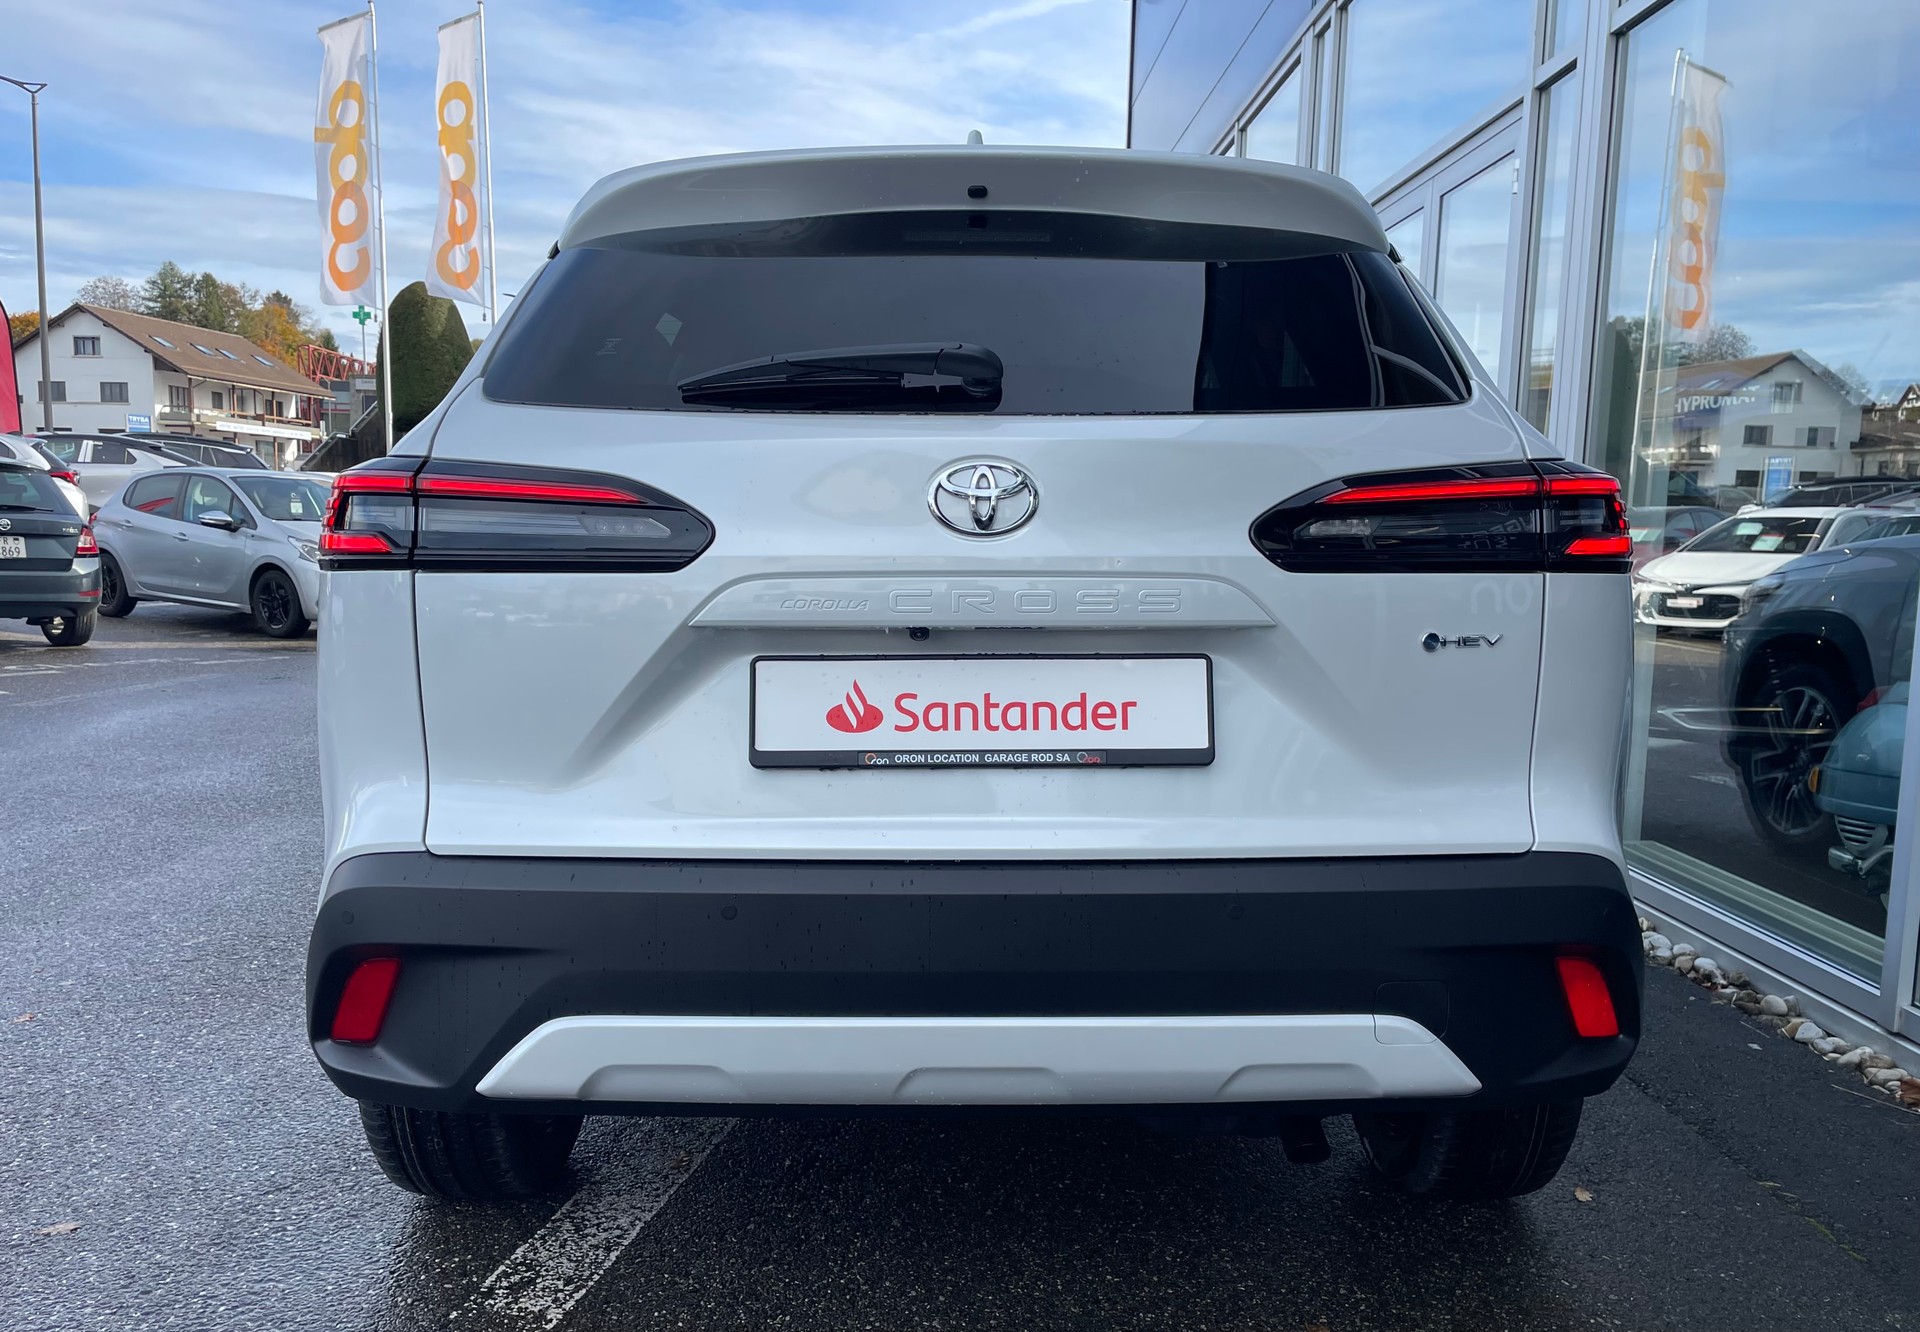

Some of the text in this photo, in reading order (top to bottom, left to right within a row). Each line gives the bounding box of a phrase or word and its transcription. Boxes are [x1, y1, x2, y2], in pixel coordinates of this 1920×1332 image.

[780, 588, 1183, 614] COROLLA CROSS
[1439, 633, 1503, 648] HEV
[893, 692, 1138, 733] Santander
[894, 753, 1070, 763] ORON LOCATION GARAGE ROD SA
